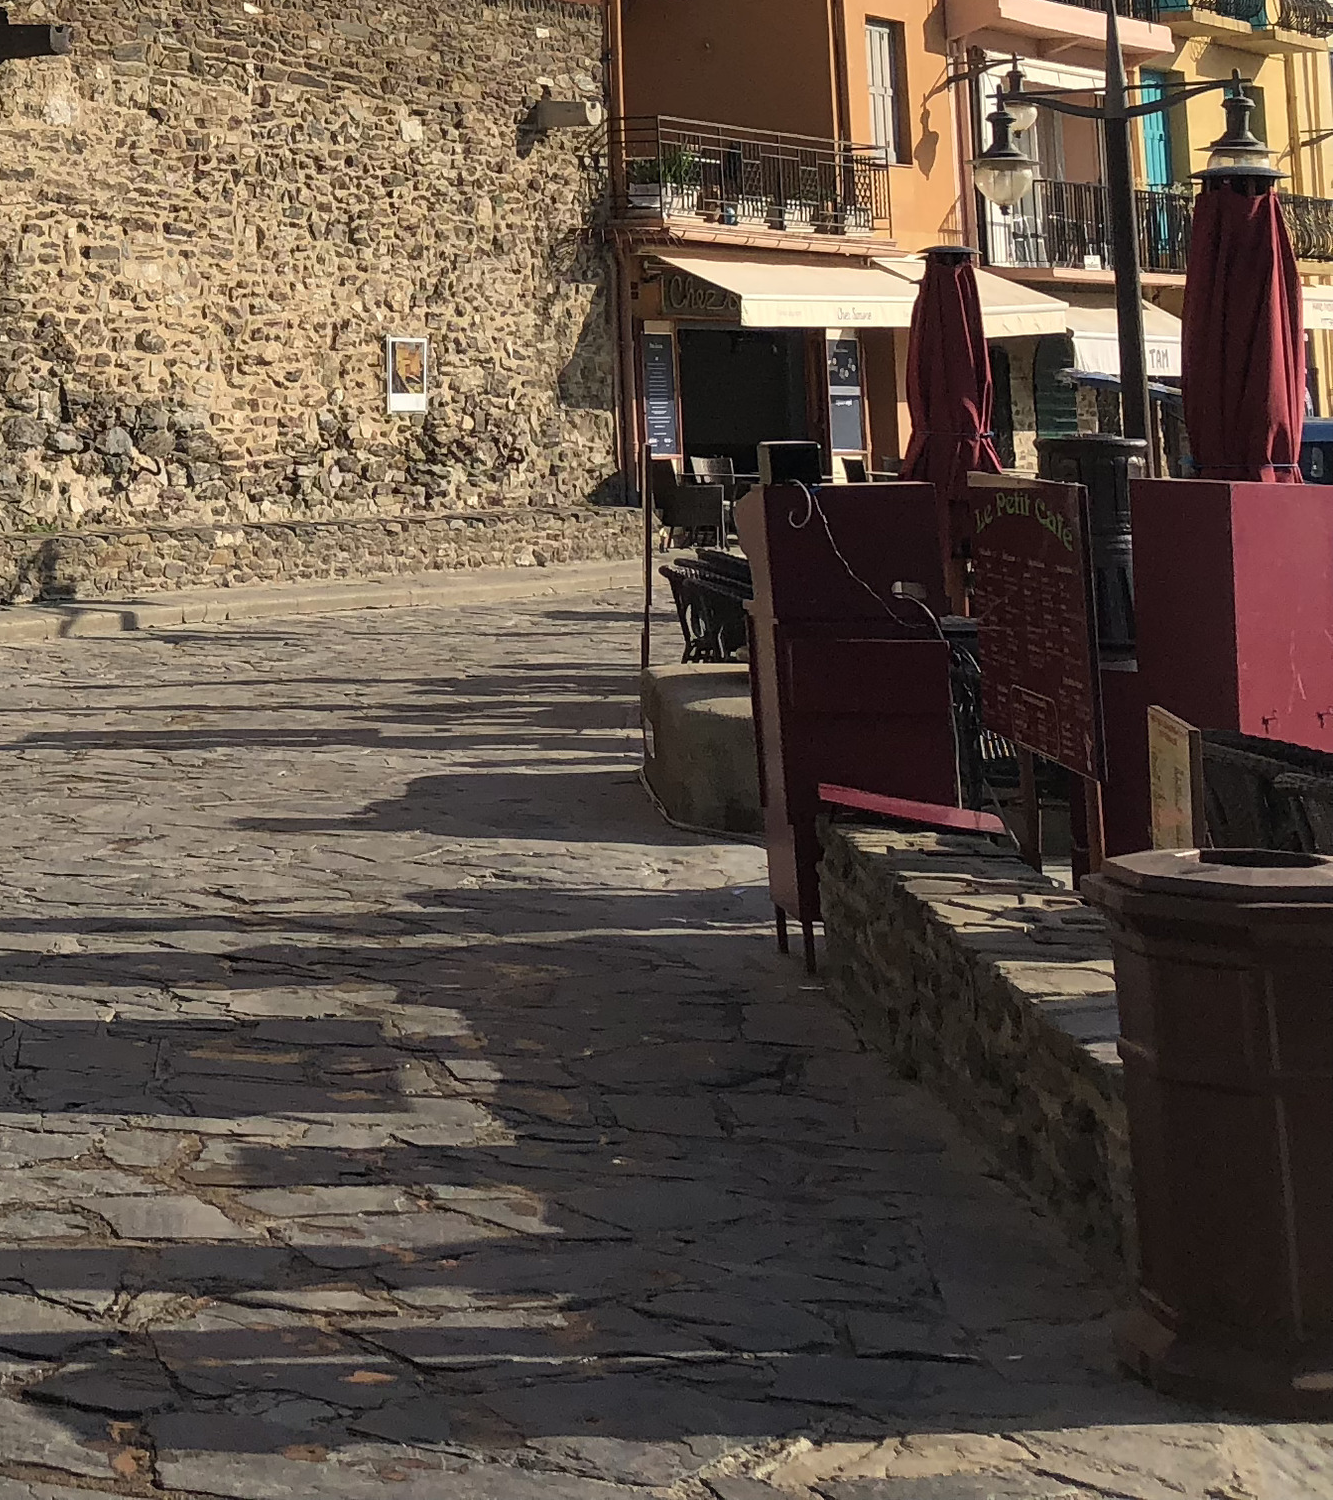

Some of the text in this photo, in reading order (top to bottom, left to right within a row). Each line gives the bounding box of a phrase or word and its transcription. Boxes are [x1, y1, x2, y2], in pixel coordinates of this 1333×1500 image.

[669, 275, 720, 309] Chez
[974, 492, 1073, 552] Le Petit Café
